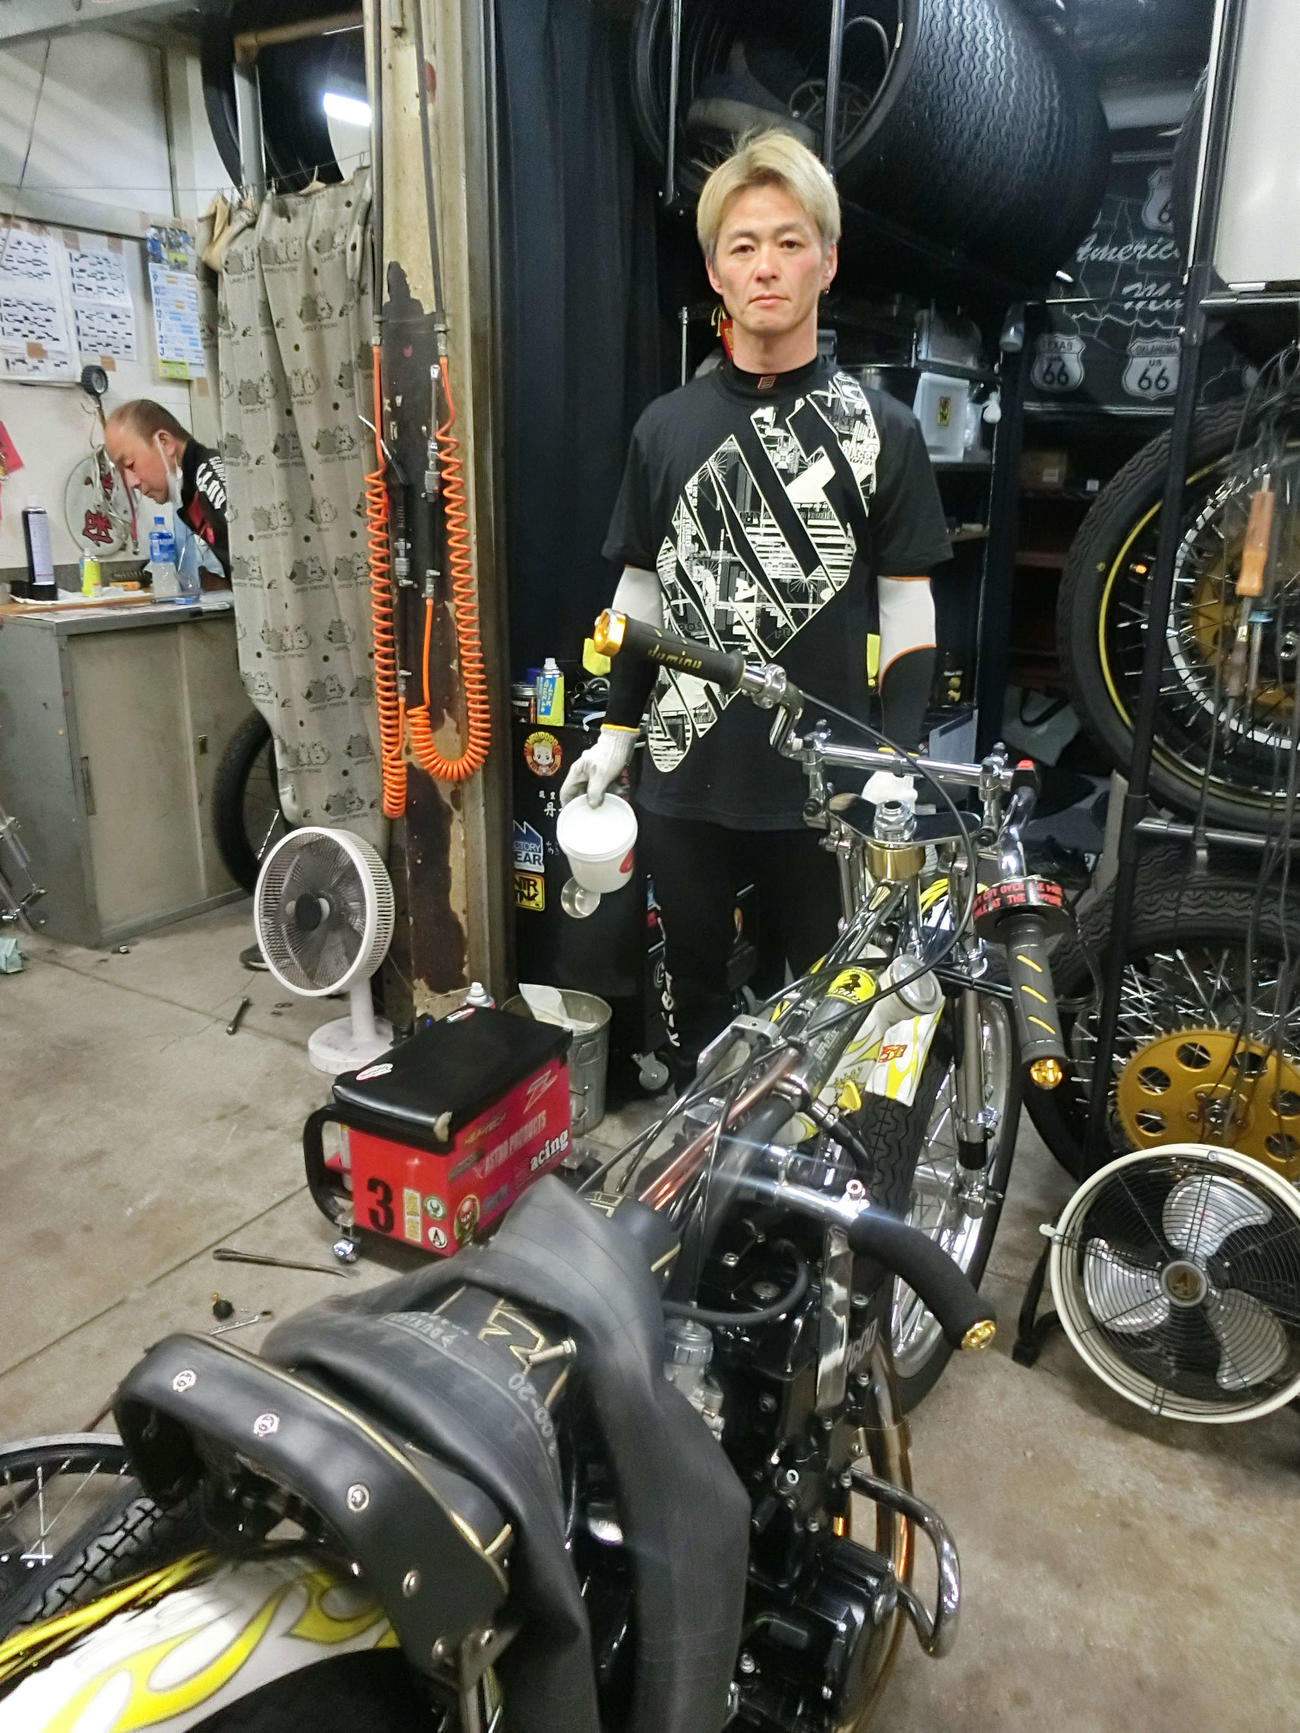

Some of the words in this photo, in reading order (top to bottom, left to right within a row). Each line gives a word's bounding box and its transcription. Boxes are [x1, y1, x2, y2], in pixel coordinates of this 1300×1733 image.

[1077, 233, 1180, 262] Americ
[1043, 362, 1069, 386] 66
[1149, 359, 1162, 367] US
[1138, 366, 1169, 391] 66
[514, 852, 542, 865] EAR
[1007, 893, 1026, 904] THE
[529, 1129, 569, 1171] acing
[367, 1178, 395, 1234] 3
